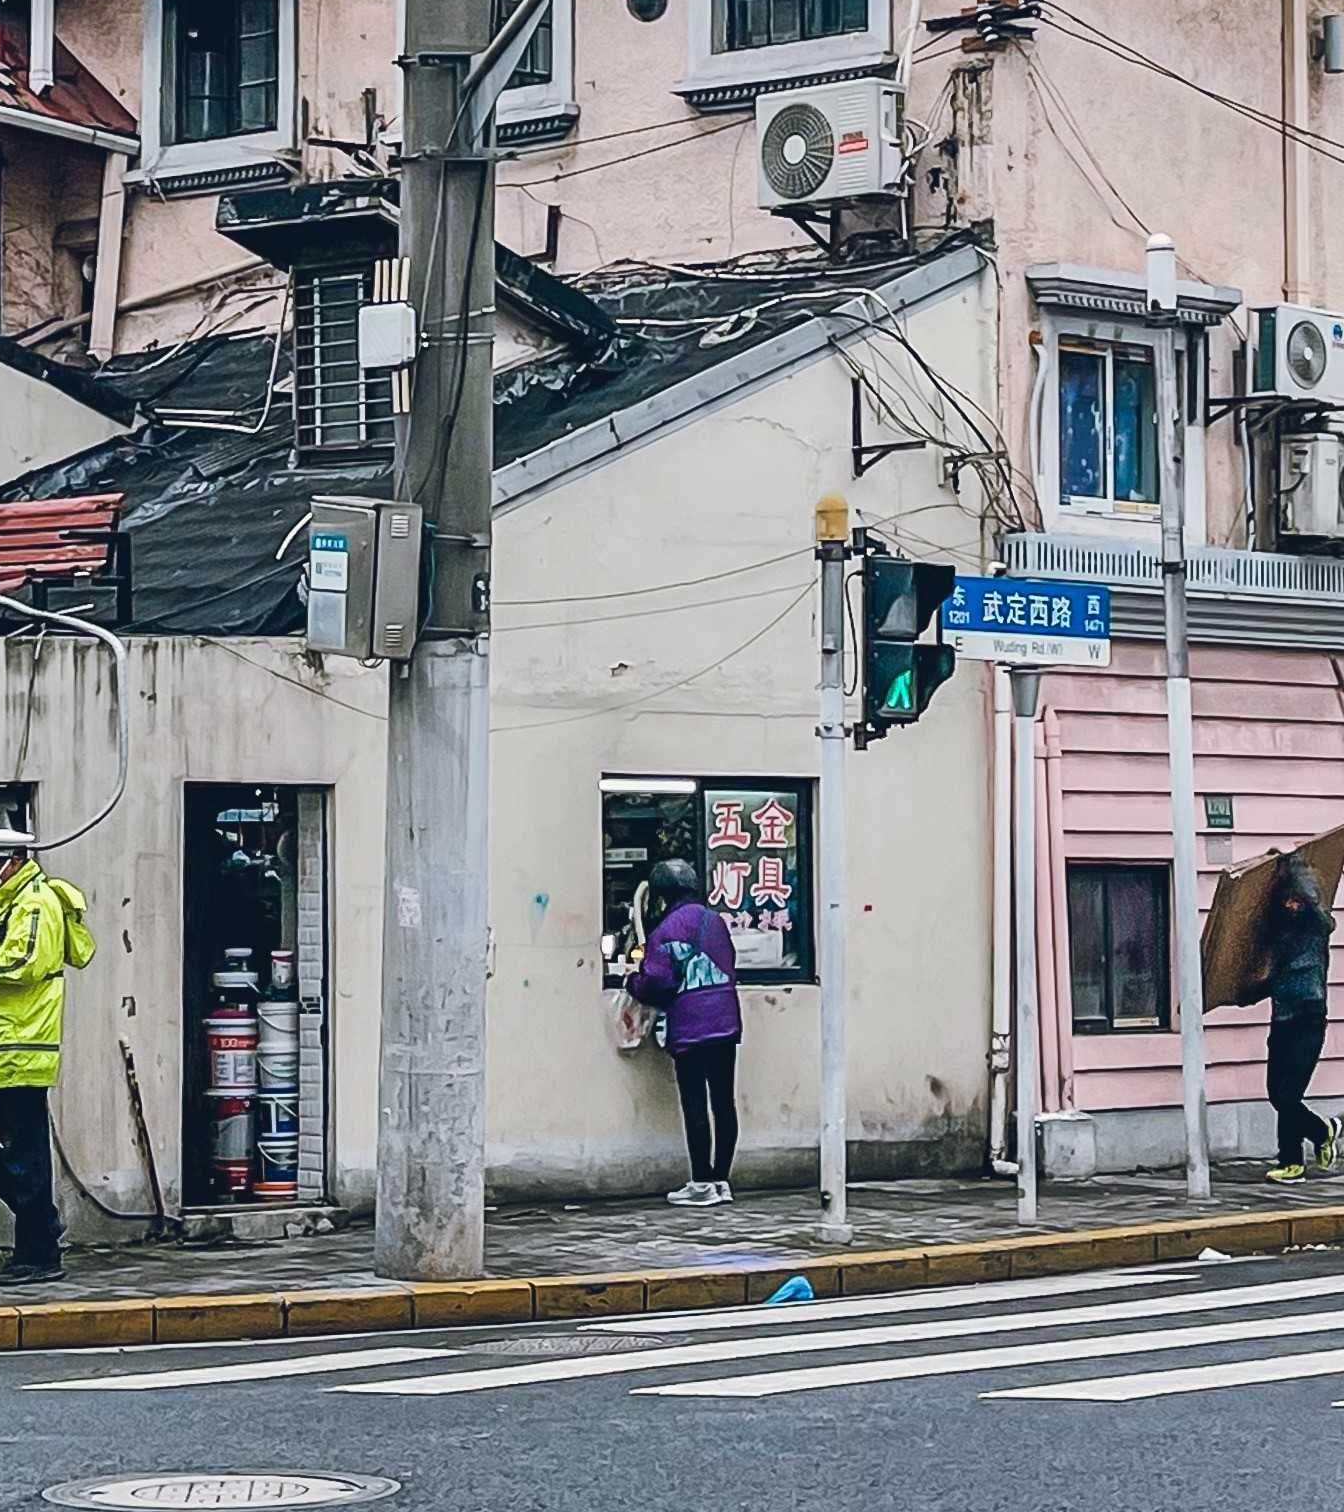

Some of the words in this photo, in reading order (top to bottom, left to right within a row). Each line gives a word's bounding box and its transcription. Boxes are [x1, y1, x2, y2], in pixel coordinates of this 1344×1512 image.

[982, 591, 1072, 628] 武定西路
[1086, 595, 1101, 615] 西
[956, 636, 963, 652] E
[1088, 644, 1101, 659] W
[708, 798, 795, 849] 五金
[708, 856, 793, 909] 灯具
